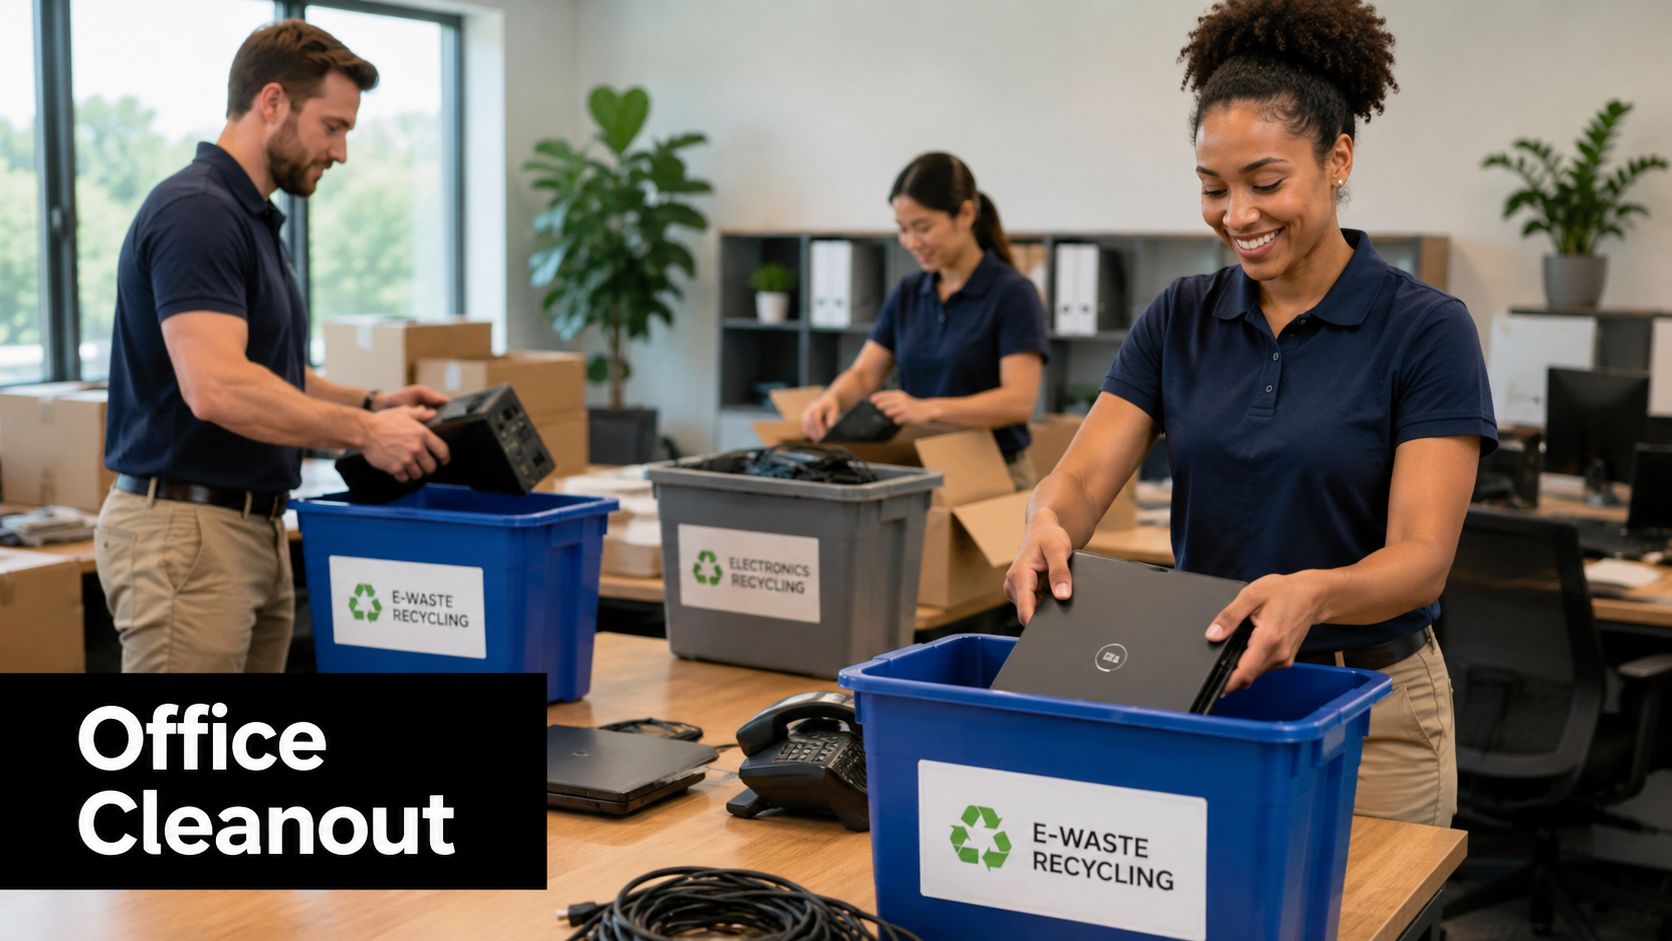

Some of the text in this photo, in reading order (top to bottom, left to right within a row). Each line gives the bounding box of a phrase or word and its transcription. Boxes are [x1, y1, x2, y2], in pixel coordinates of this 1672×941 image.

[729, 557, 810, 577] ELECTRONICS
[731, 574, 805, 594] RECYCLING
[392, 590, 453, 608] E-WASTE
[393, 609, 469, 628] RECYCLING
[1033, 822, 1149, 858] E-WASTE
[1033, 851, 1174, 891] RECYCLING
